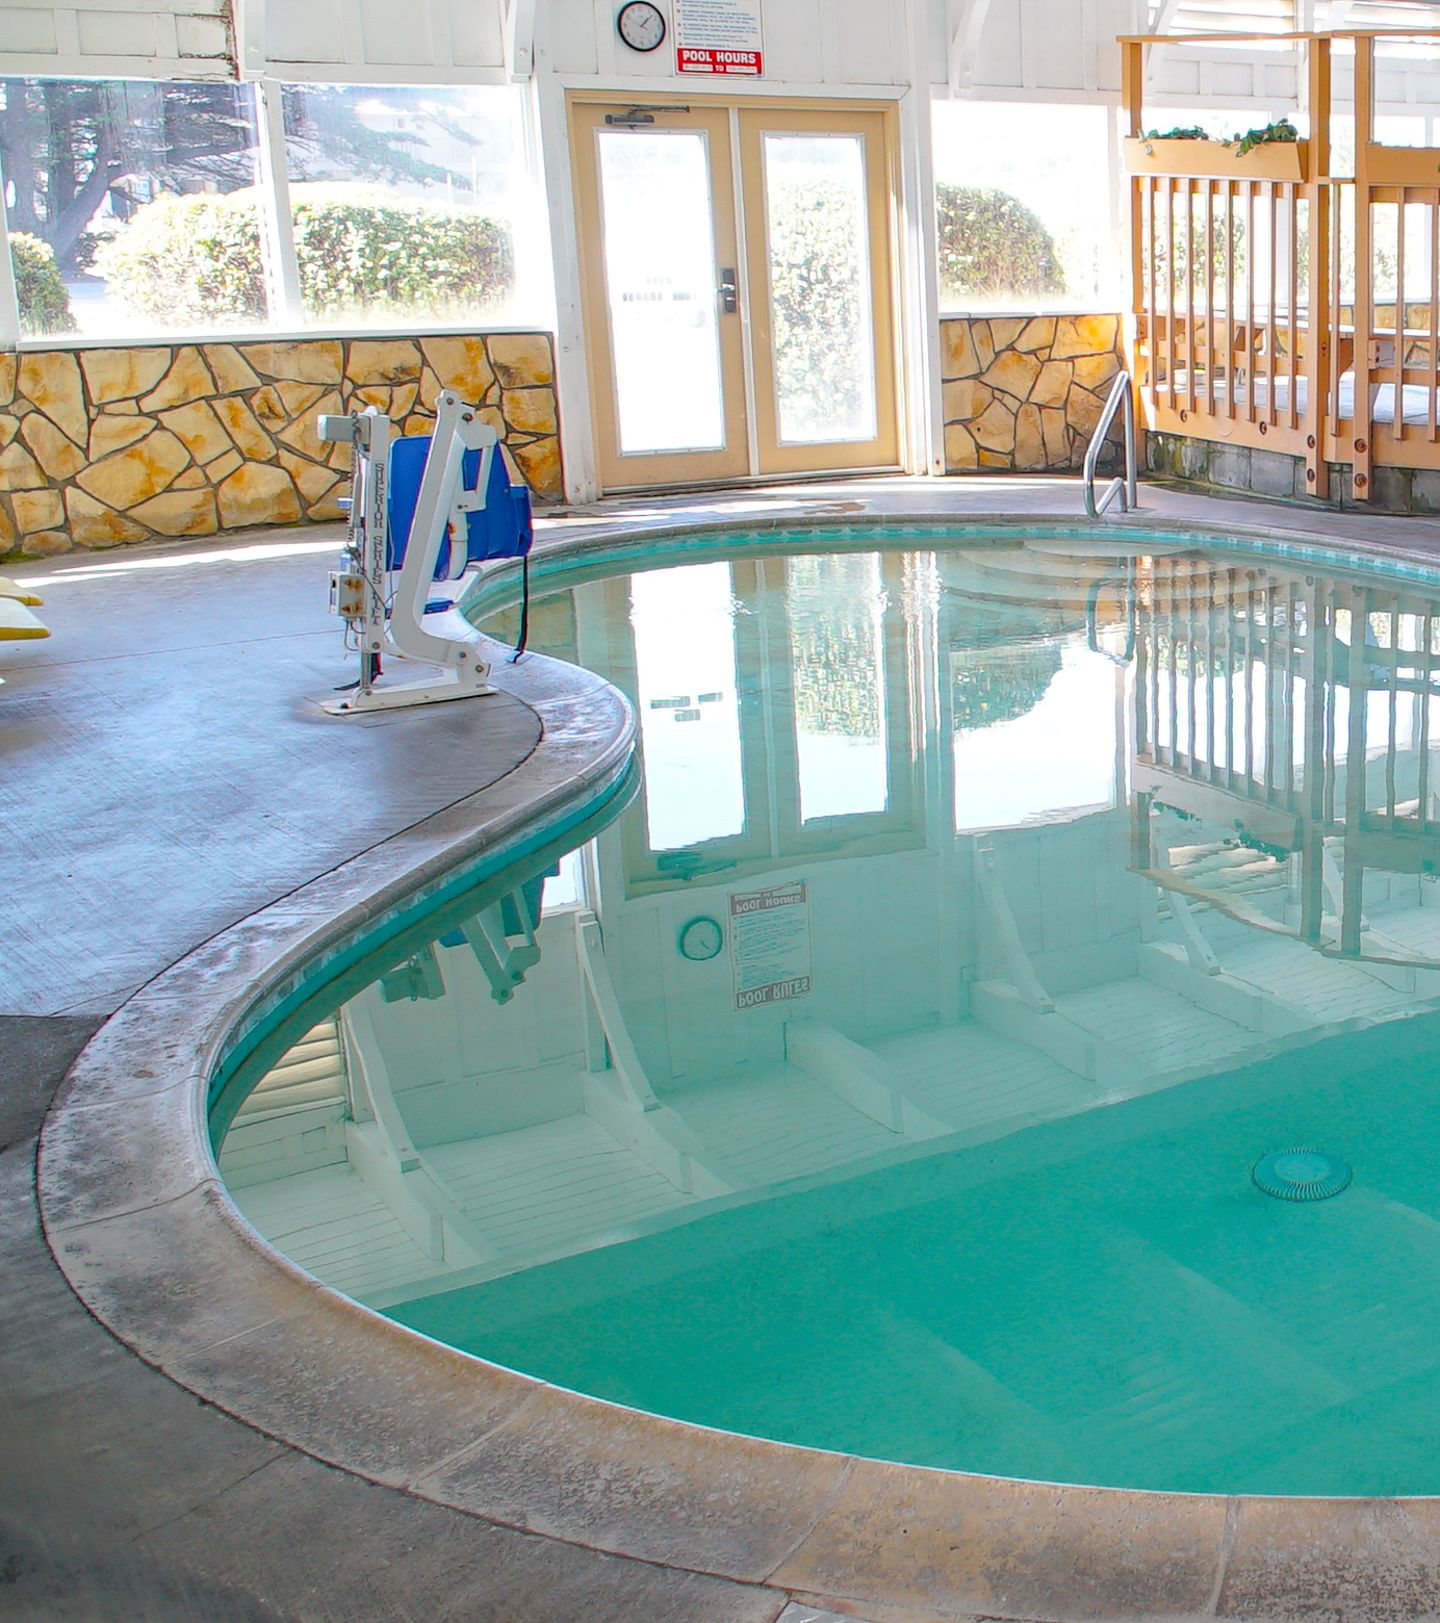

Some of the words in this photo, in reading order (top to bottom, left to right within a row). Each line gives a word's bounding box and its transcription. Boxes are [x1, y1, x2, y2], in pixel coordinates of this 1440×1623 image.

[682, 50, 712, 62] POOL
[716, 51, 757, 64] HOURS
[374, 463, 385, 528] SUPERIOR
[373, 535, 383, 584] SERIES
